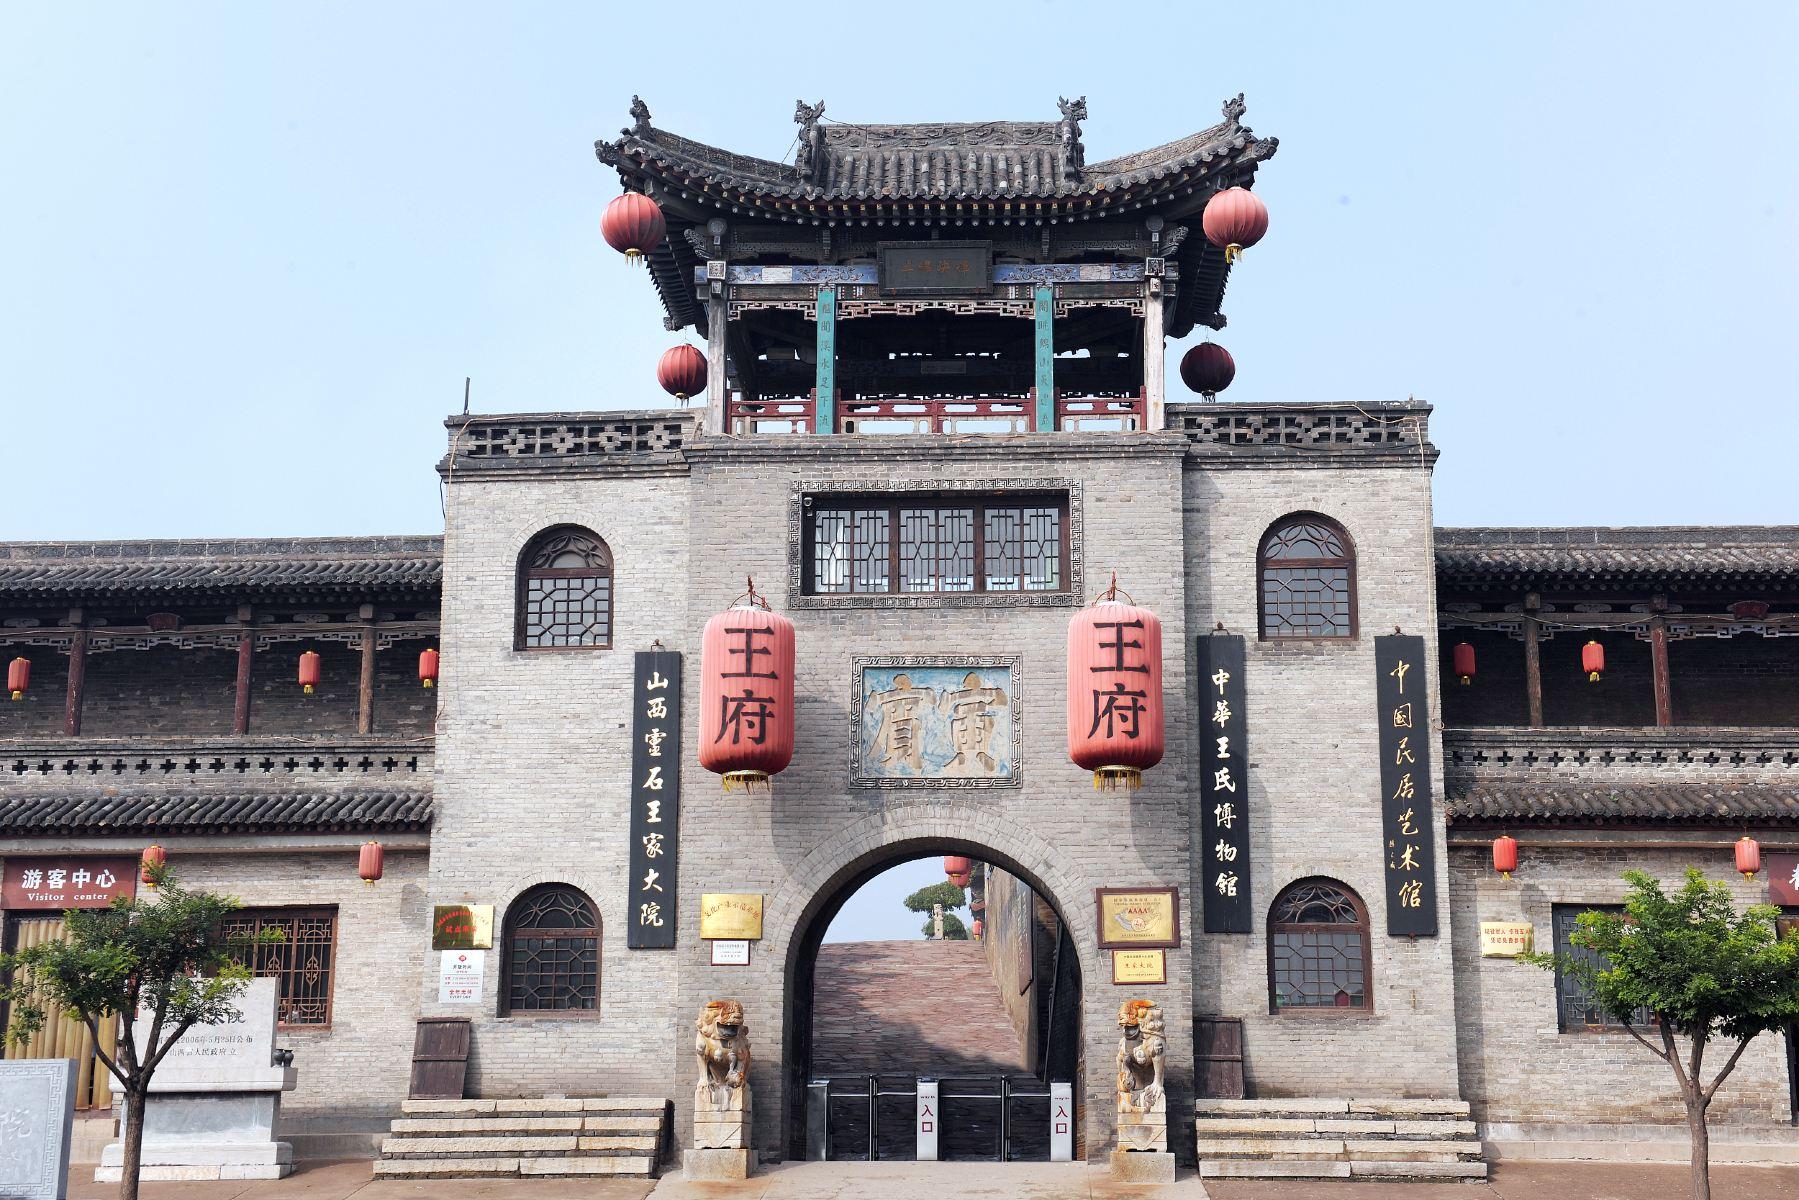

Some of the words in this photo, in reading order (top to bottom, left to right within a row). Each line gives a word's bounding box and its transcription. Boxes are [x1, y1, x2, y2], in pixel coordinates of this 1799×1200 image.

[715, 626, 778, 745] 王府
[1088, 619, 1149, 739] 王府
[21, 868, 116, 889] 游客中心
[28, 892, 65, 901] Visitor
[74, 893, 108, 901] center
[921, 1104, 934, 1133] 入口
[1055, 1105, 1068, 1134] 入口
